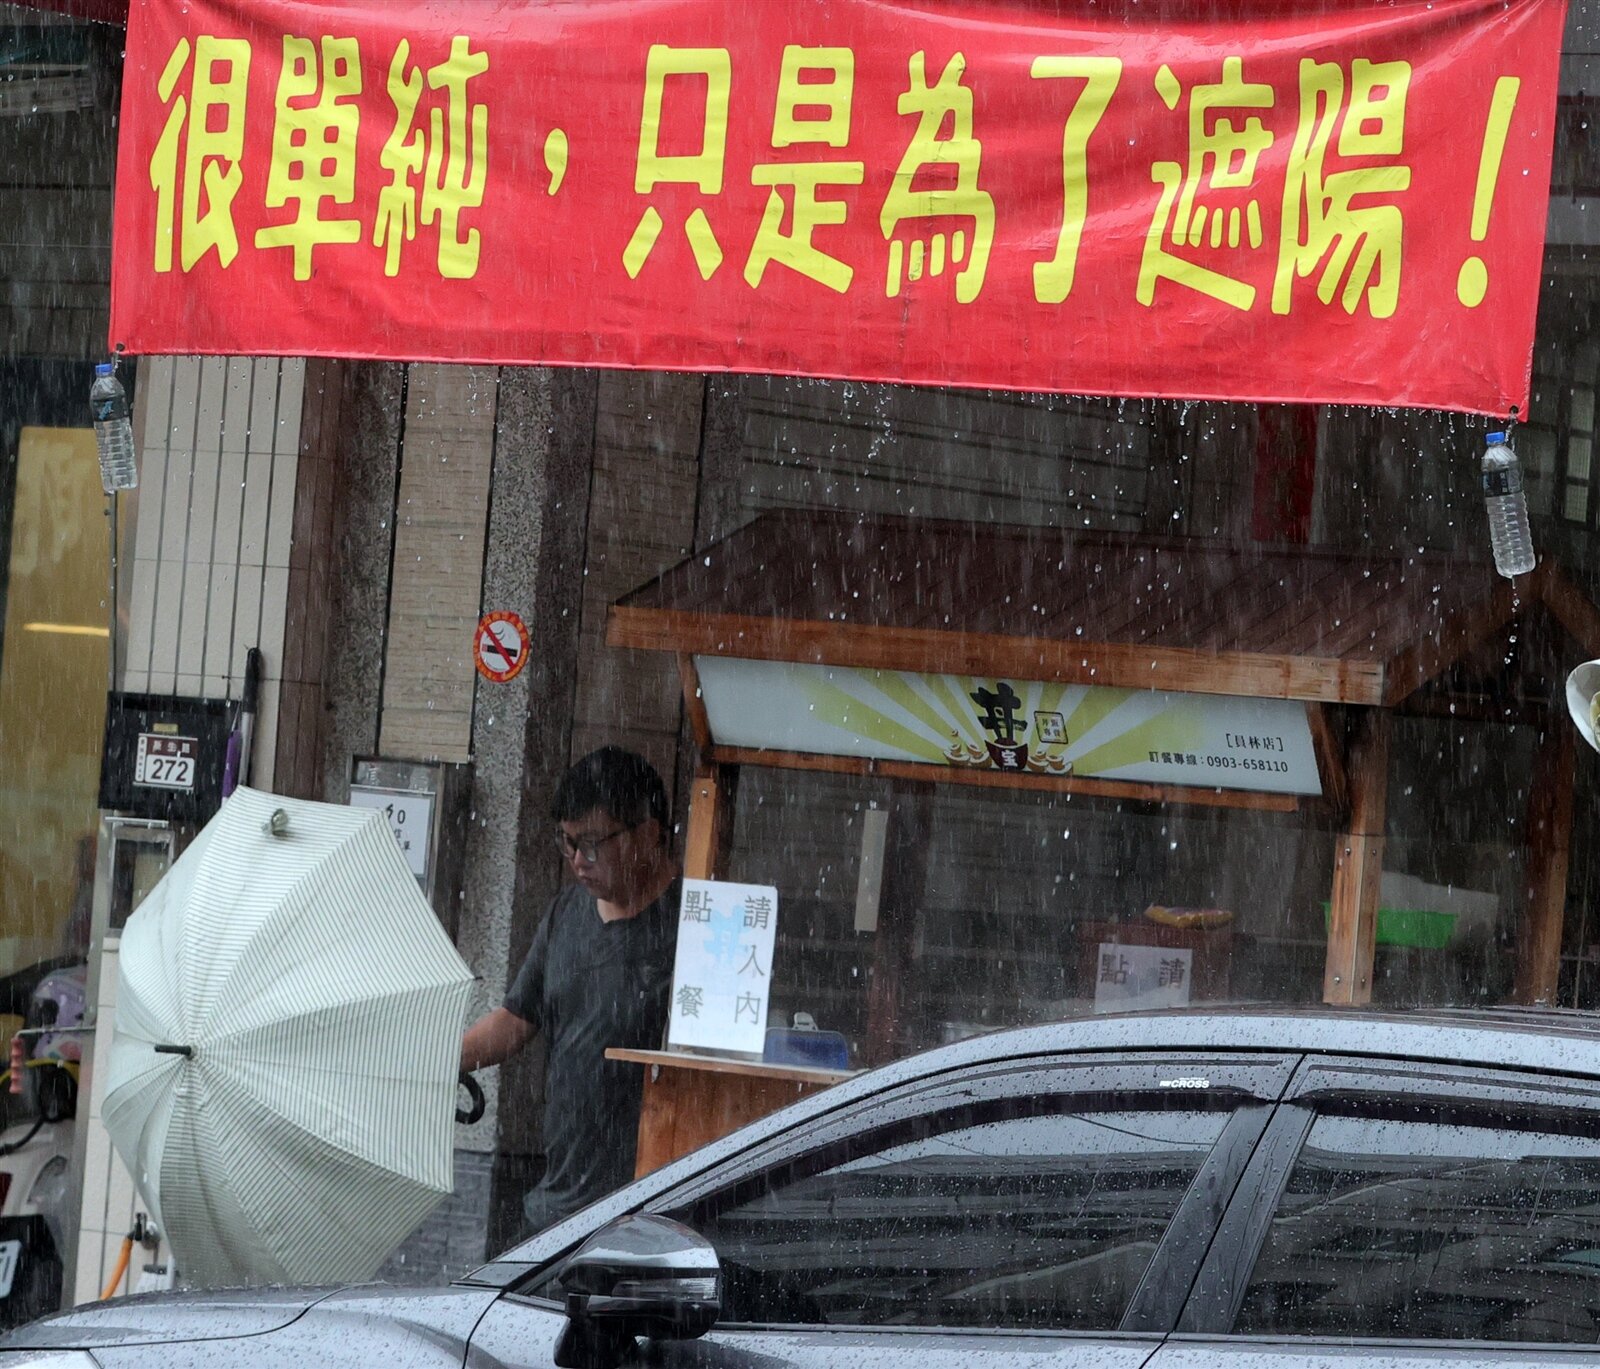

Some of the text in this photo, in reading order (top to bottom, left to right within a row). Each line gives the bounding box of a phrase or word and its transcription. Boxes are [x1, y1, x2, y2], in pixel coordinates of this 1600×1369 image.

[150, 34, 1520, 318] 很單純，只是為了遮陽！
[151, 758, 189, 782] 272
[675, 889, 713, 1020] 點餐
[734, 895, 772, 1025] 請入內
[1100, 953, 1129, 985] 點
[1159, 957, 1185, 989] 請
[1171, 1080, 1210, 1089] CROSS
